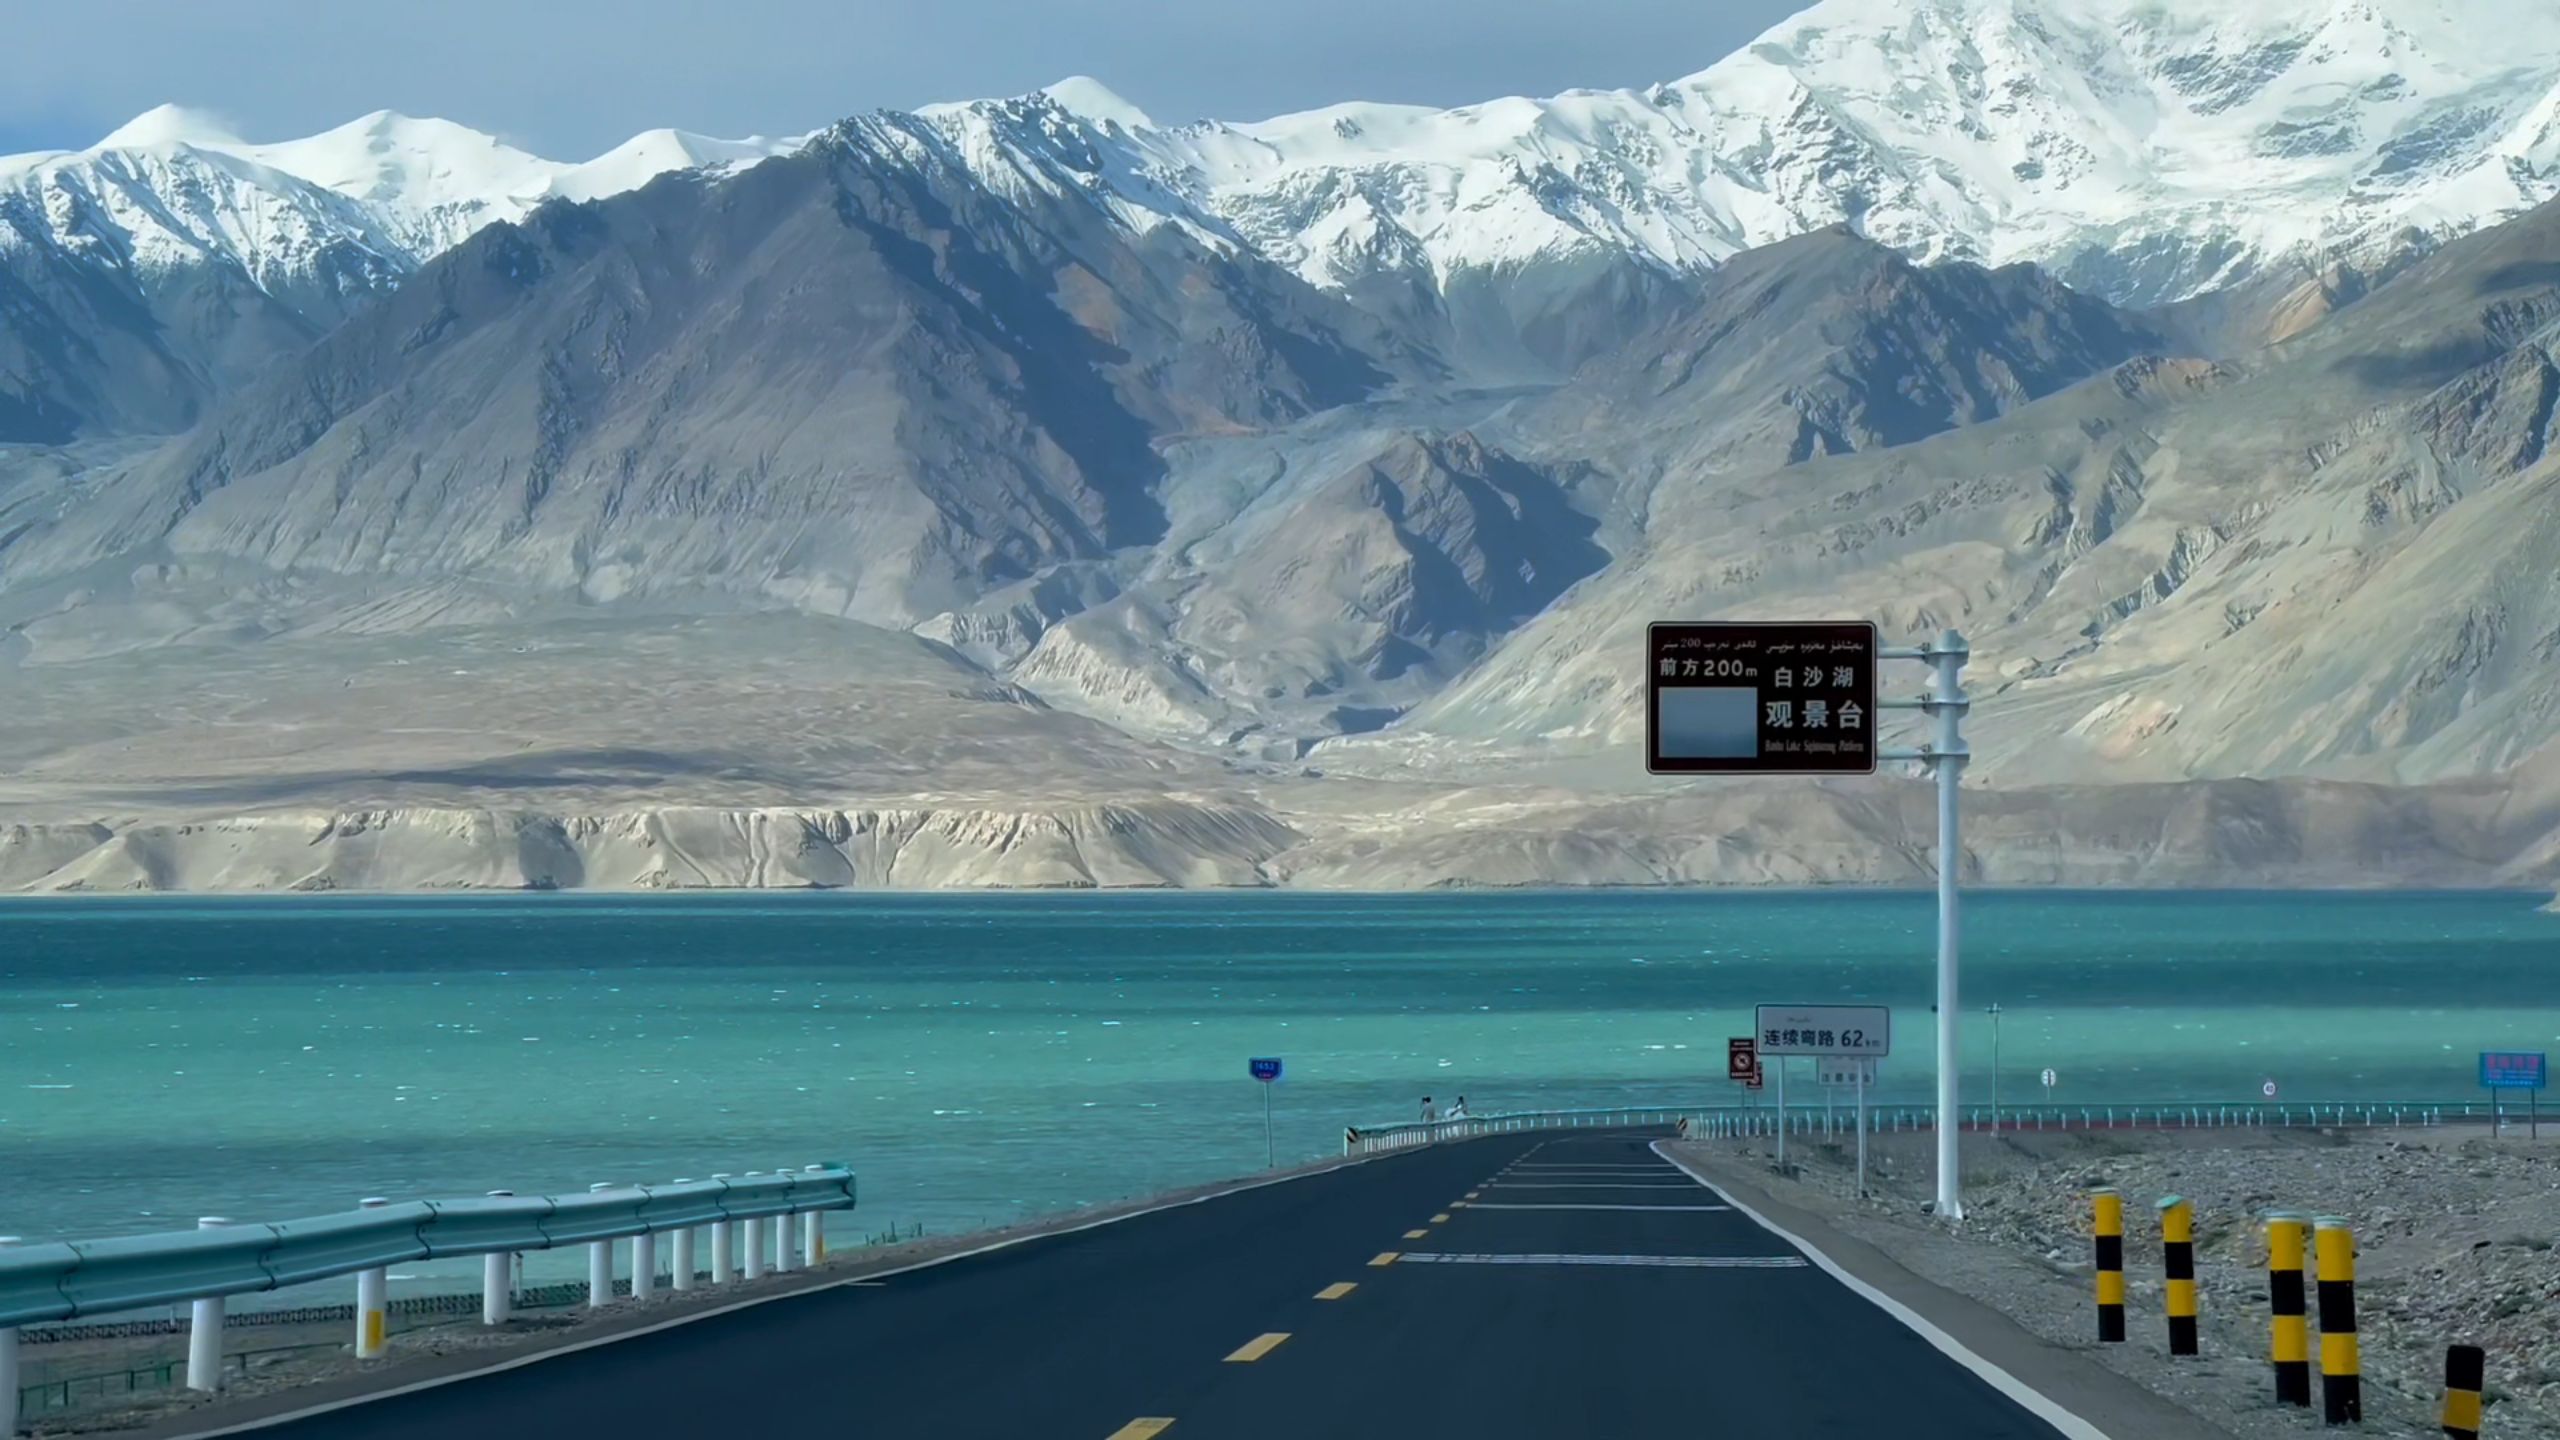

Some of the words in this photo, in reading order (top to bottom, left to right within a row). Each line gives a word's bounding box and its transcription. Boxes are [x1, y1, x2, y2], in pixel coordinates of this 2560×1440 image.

[1774, 666, 1854, 688] 白沙湖
[1765, 700, 1864, 728] 观景台
[1764, 1029, 1834, 1047] 连续弯路
